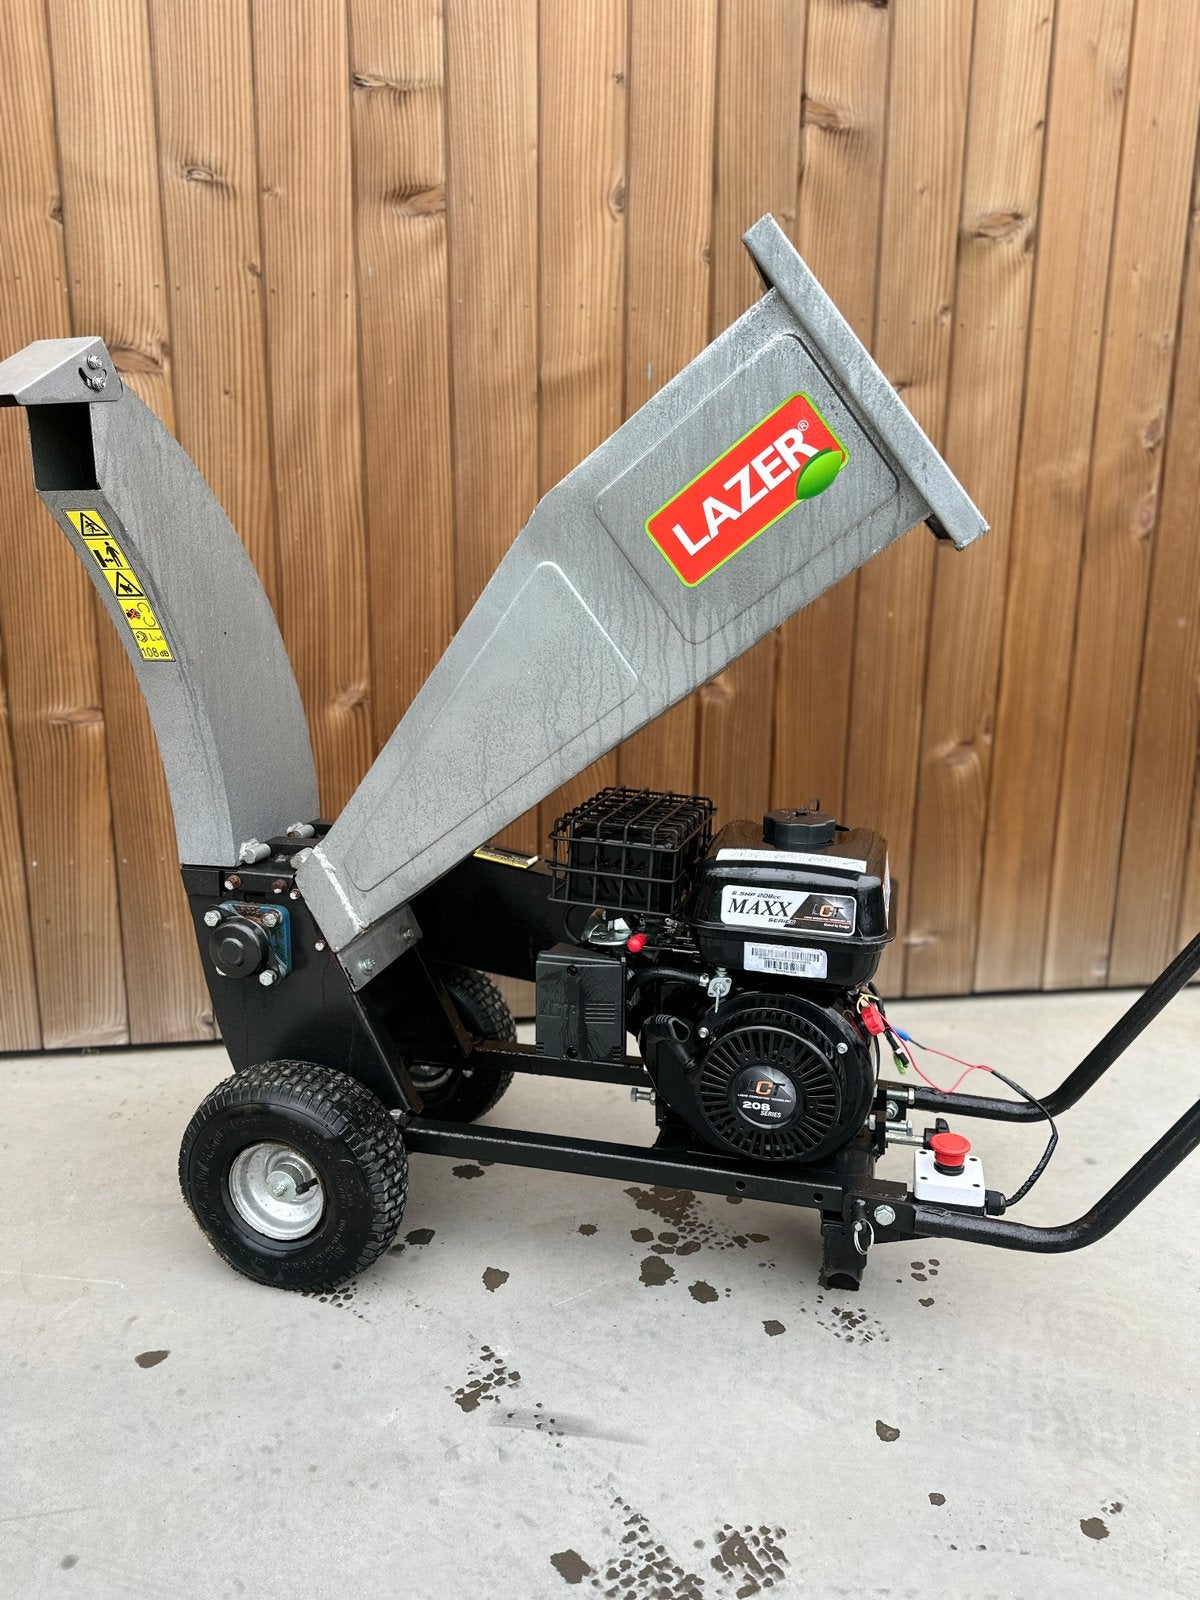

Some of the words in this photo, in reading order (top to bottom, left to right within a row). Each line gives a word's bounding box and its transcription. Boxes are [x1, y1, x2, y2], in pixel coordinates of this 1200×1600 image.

[727, 897, 793, 917] MAXX
[767, 917, 797, 925] SERIES
[742, 1100, 771, 1111] 208
[760, 1110, 782, 1118] SERIES
